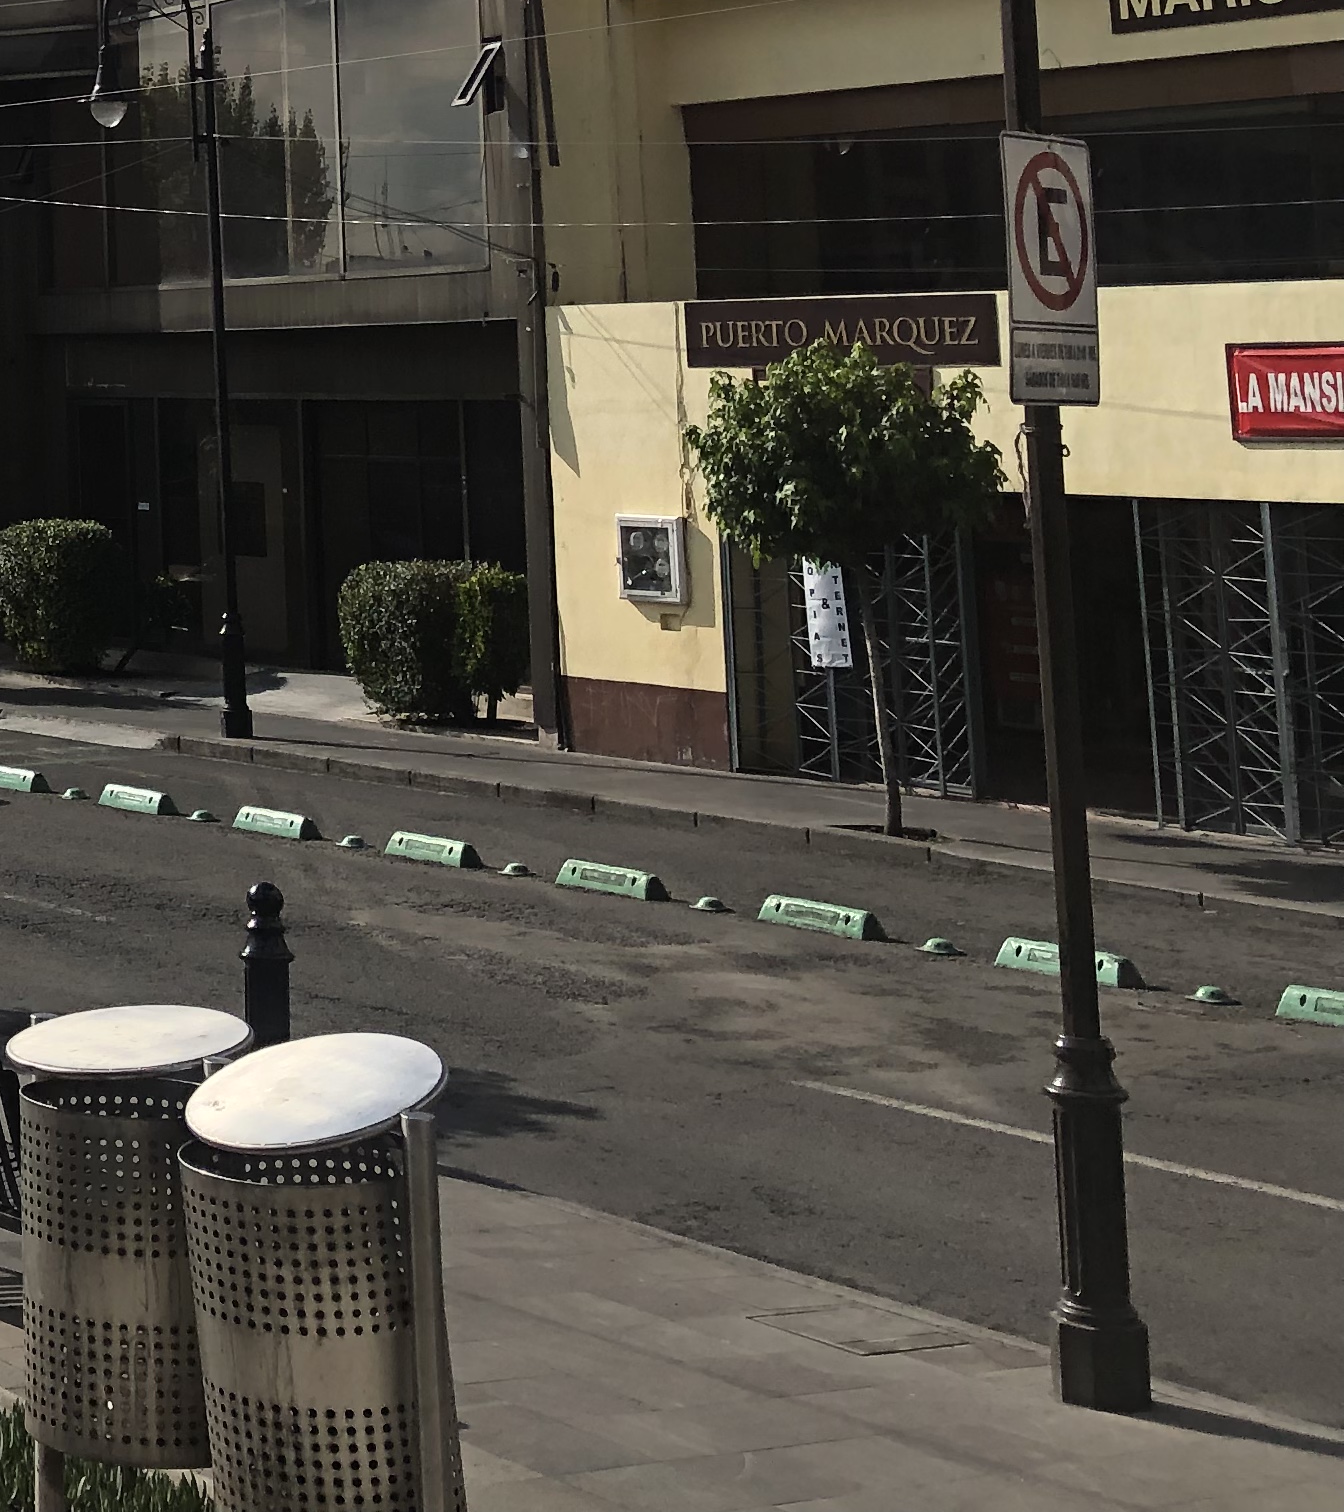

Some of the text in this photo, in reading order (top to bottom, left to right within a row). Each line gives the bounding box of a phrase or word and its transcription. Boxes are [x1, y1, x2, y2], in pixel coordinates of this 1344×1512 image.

[699, 318, 808, 349] PUERTO
[823, 315, 980, 356] MARQUEZ
[1234, 370, 1344, 413] LA MANSI
[806, 566, 824, 664] OPIAS
[831, 575, 849, 664] TERNET
